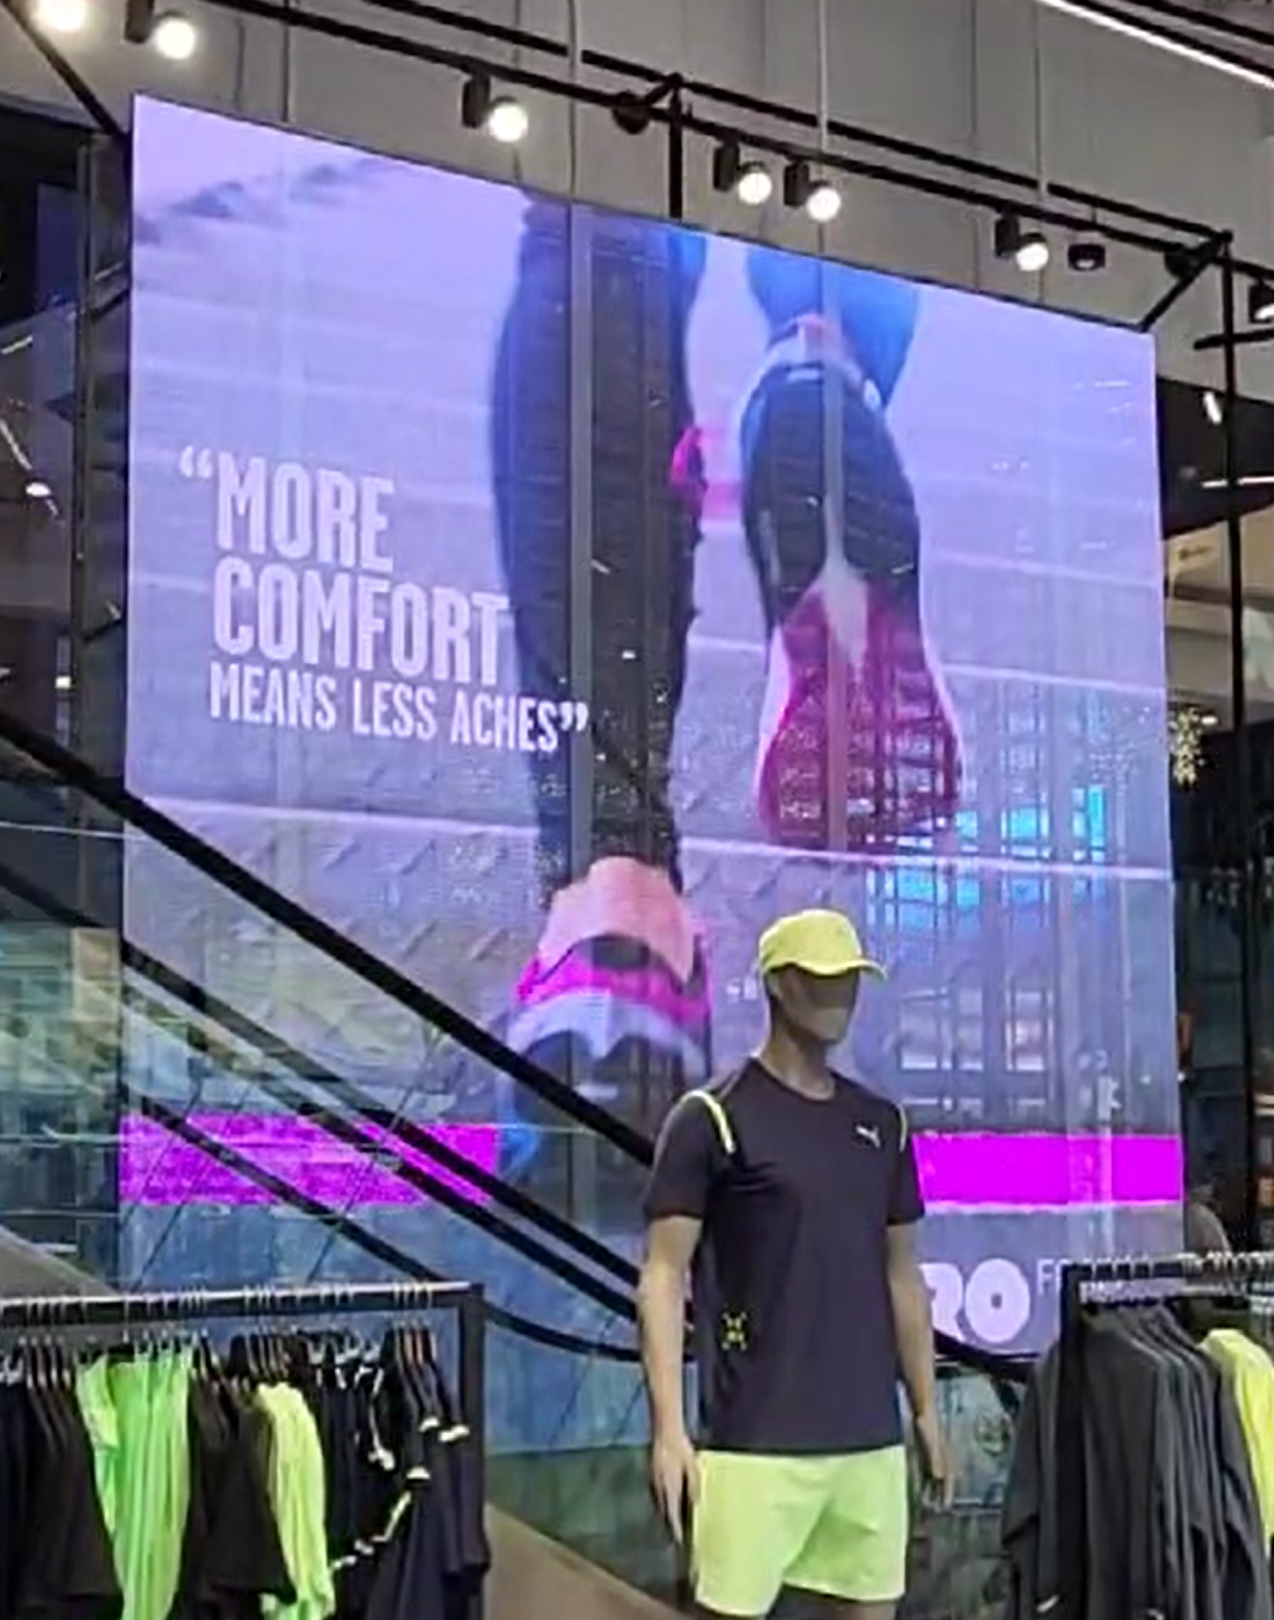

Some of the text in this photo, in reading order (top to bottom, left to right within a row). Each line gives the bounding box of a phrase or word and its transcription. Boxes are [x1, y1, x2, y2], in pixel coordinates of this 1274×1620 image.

[178, 445, 394, 573] “MORE
[213, 556, 509, 686] COMFORT
[209, 661, 589, 753] MEANS LESS ACHES”
